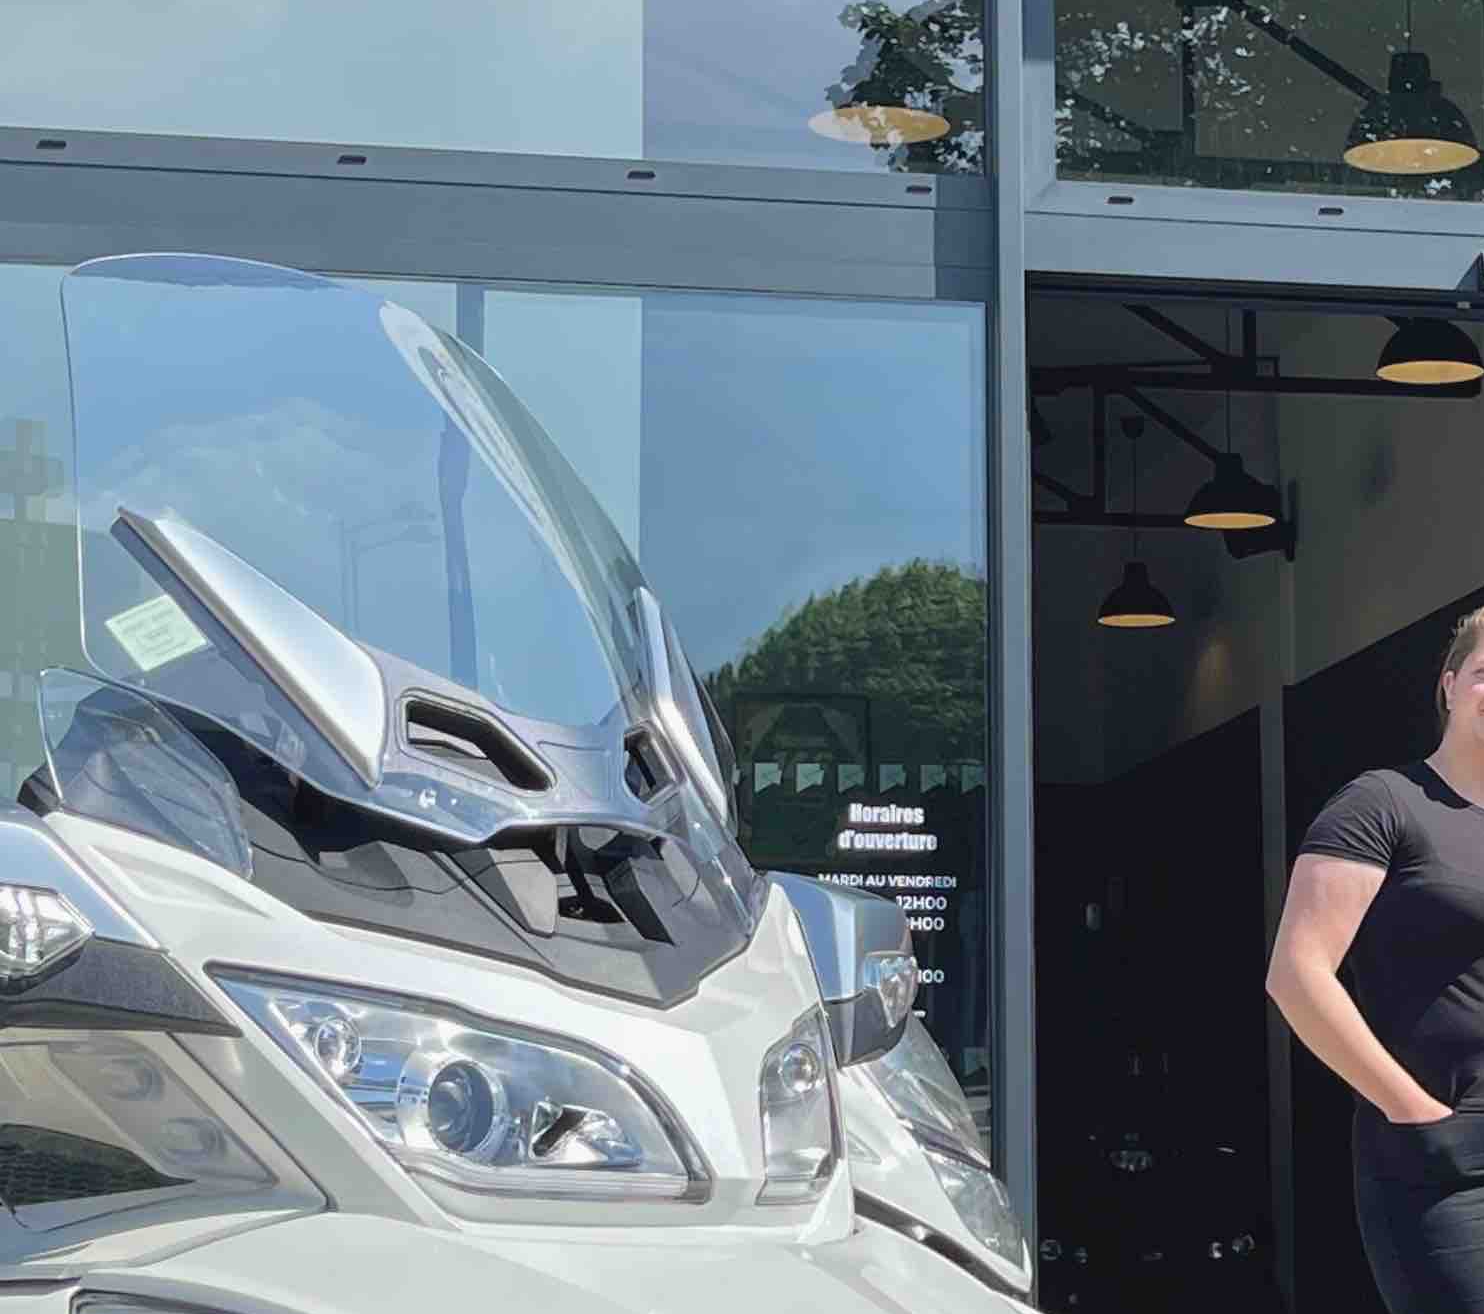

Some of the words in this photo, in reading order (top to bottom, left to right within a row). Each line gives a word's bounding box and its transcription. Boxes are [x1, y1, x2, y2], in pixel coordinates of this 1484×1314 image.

[849, 802, 925, 824] Horaires
[838, 829, 938, 852] d'ouverture
[818, 873, 863, 886] MARDI
[865, 874, 886, 886] AU
[888, 875, 957, 888] VENDREDI
[896, 895, 947, 910] 12H00
[906, 916, 945, 931] H00
